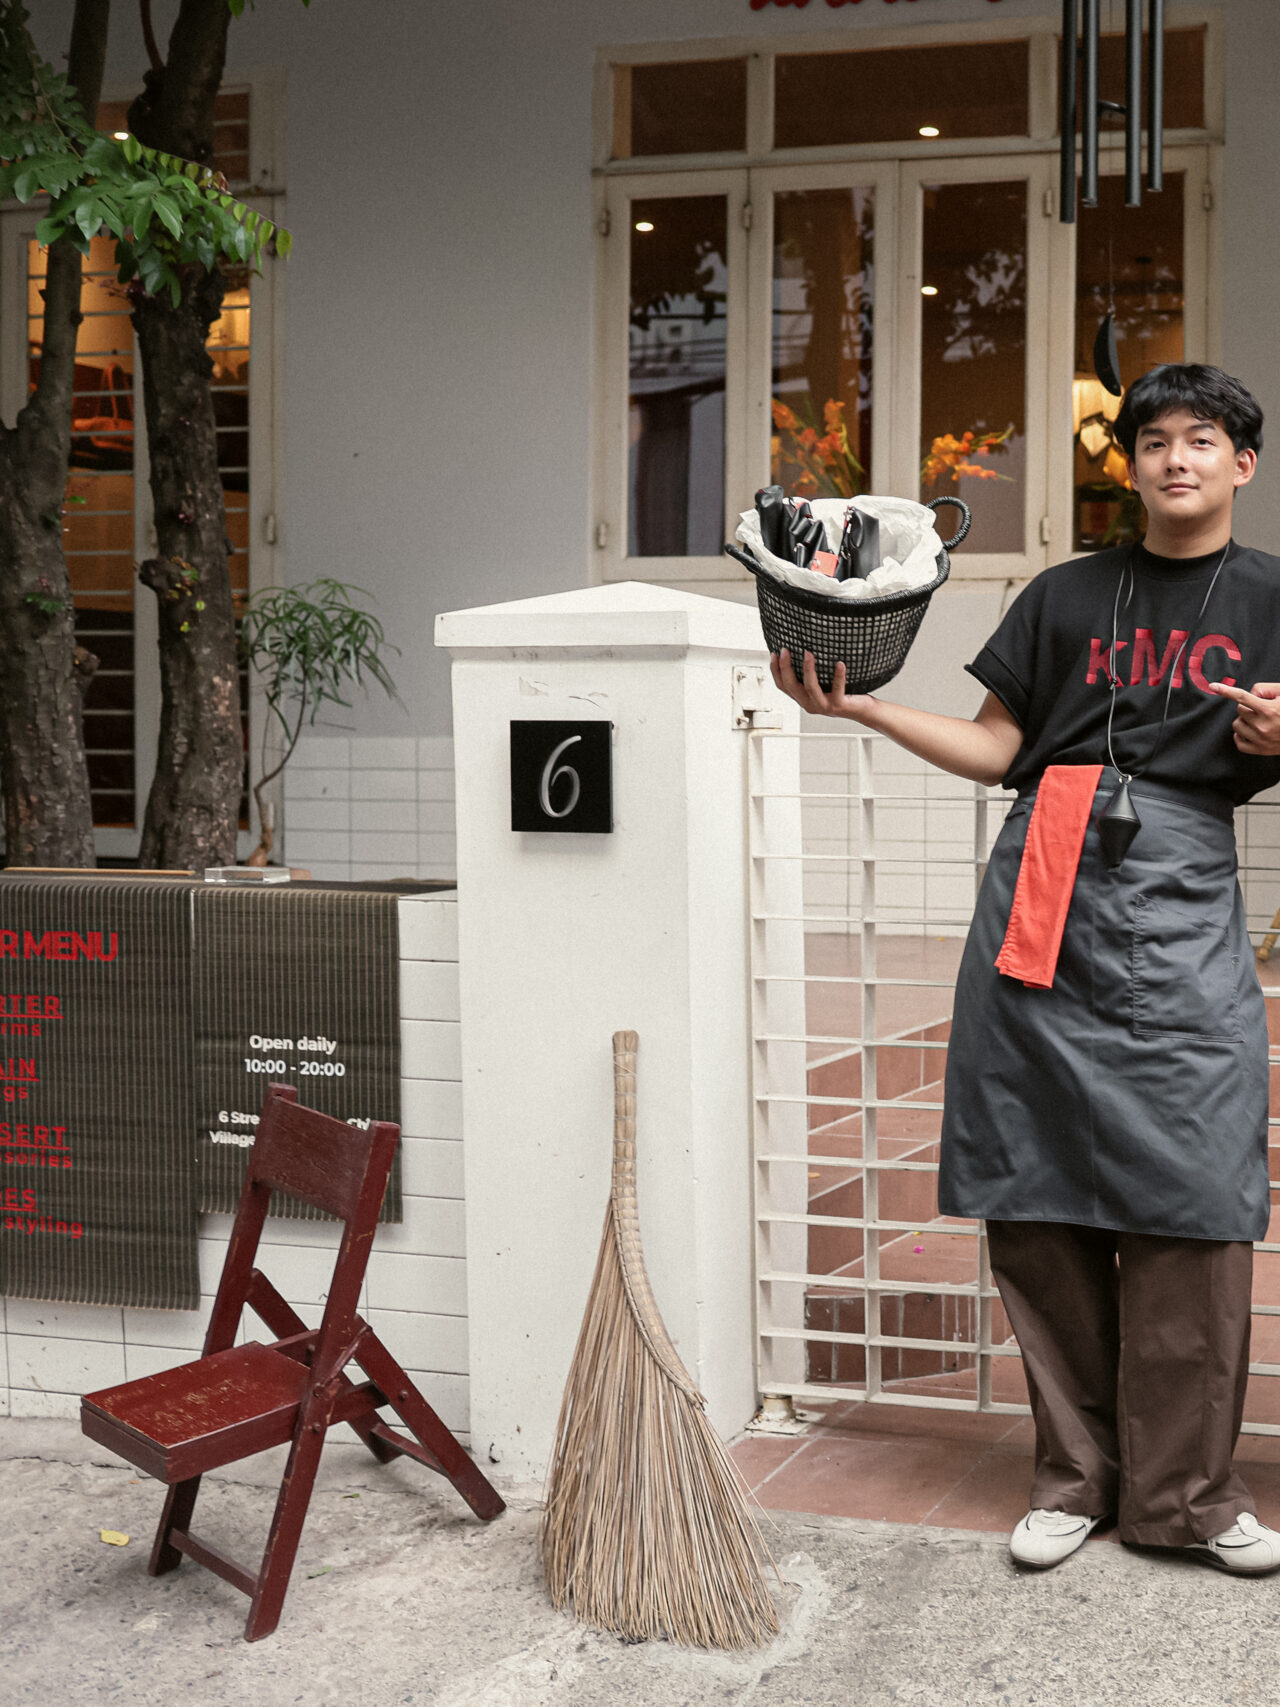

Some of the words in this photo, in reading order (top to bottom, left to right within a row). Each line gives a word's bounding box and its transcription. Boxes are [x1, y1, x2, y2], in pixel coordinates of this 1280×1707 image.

[1085, 628, 1242, 696] KMC
[539, 735, 582, 818] 6
[24, 930, 119, 962] MENU
[250, 1035, 293, 1052] Open
[297, 1036, 337, 1055] daily
[244, 1058, 286, 1074] 10:00
[299, 1061, 346, 1077] 20:00
[218, 1110, 229, 1123] 6
[0, 1150, 73, 1169] sories
[5, 1215, 83, 1239] styling
